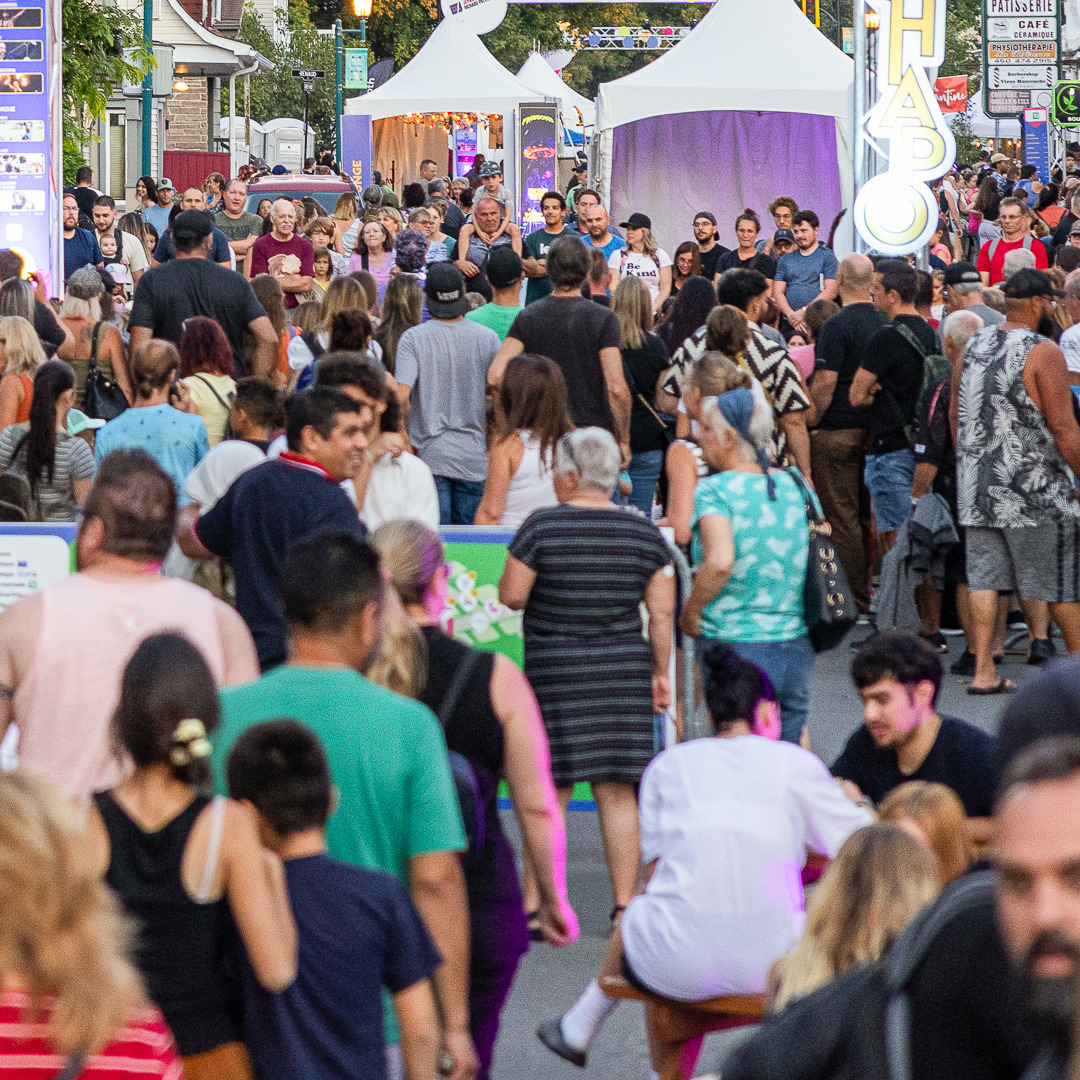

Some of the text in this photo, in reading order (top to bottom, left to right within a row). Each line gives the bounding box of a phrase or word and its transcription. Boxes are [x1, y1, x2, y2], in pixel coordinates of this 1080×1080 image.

[1018, 19, 1050, 29] CAFÉ
[1013, 31, 1054, 39] CÉRAMIQUE
[992, 42, 1053, 51] PHYSIOTHÉRAPIE
[627, 262, 640, 270] Be
[626, 269, 656, 277] Kind
